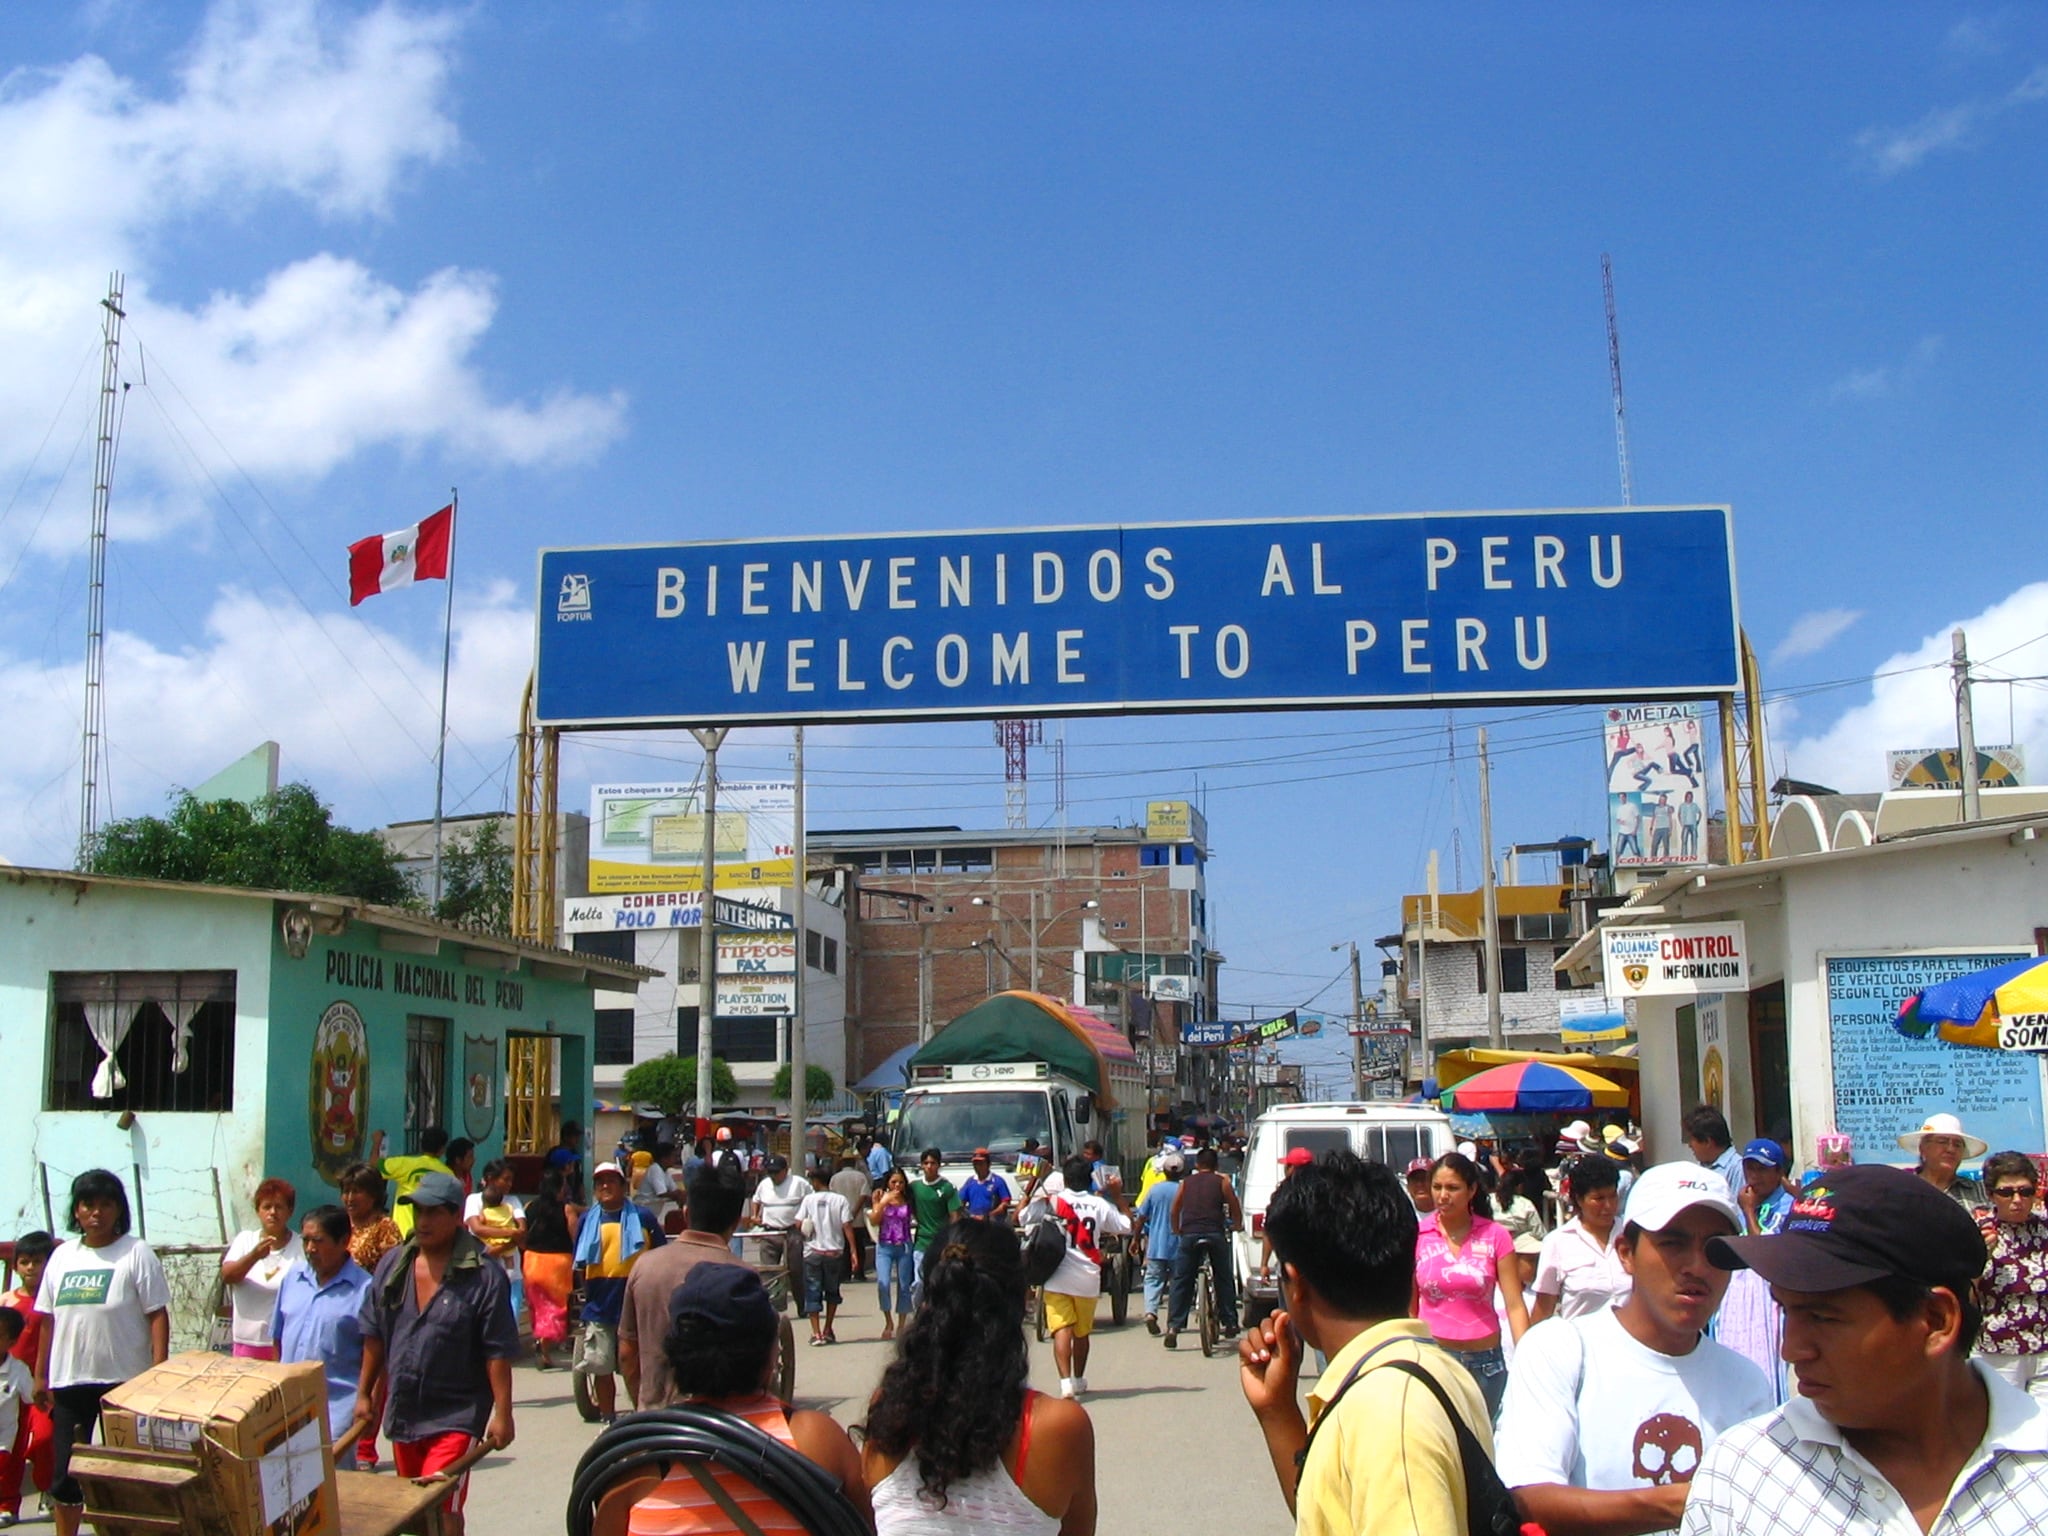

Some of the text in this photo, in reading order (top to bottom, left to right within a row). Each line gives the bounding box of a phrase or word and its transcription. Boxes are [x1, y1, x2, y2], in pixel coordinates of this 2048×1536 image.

[656, 534, 1622, 619] BIENVENIDOS AL PERU
[557, 611, 592, 622] FOPTUR
[727, 615, 1548, 694] WELCOME TO PERU
[1626, 705, 1696, 722] METAL
[1610, 940, 1659, 954] ADUANAS
[1661, 935, 1739, 960] CONTROL
[737, 959, 767, 972] FAX
[1663, 961, 1739, 980] INFORMACION
[1828, 960, 1909, 973] REQUISITOS
[1912, 960, 1944, 971] PARA
[1948, 957, 1962, 970] EL
[326, 949, 524, 1012] POLICIA NACIONAL DEL PERU
[1829, 975, 1845, 986] DE
[1849, 973, 1922, 985] VEHICULOS
[1925, 973, 1933, 983] Y
[717, 993, 787, 1005] PLAYSTATION
[1830, 987, 1870, 1000] SEGUN
[1873, 987, 1888, 998] EL
[1833, 1013, 1896, 1026] PERSONAS
[1188, 1031, 1202, 1042] del
[994, 1067, 1015, 1075] HINO
[1836, 1087, 1944, 1097] CONTROL DE INGRESO
[1837, 1097, 1914, 1106] CON PASAPORTE
[62, 1274, 106, 1291] SEDAL
